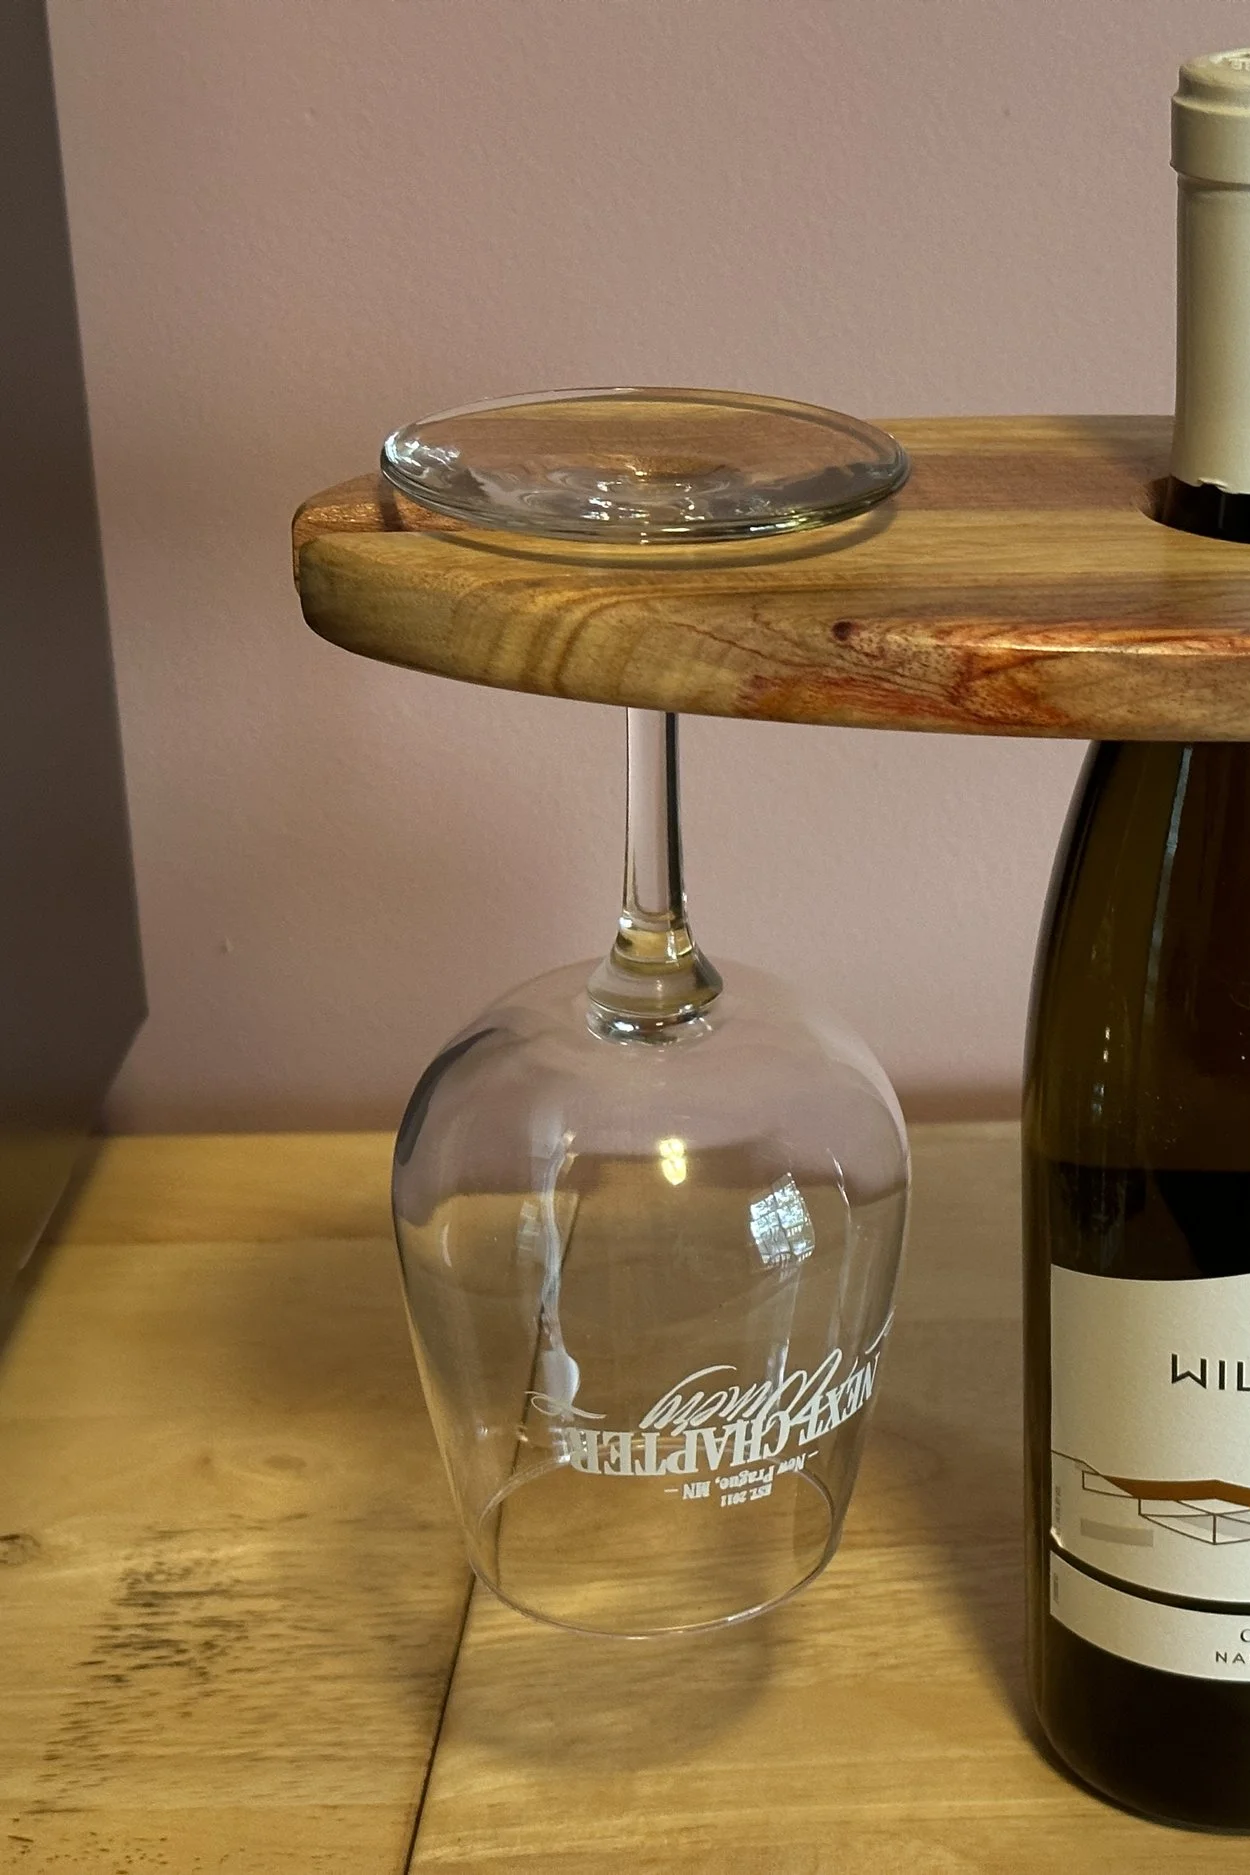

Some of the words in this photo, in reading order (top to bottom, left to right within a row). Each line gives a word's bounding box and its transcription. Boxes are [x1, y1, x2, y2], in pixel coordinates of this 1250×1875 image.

[638, 1347, 842, 1436] Winery
[798, 1351, 881, 1446] NEXT
[569, 1410, 793, 1476] CHAPTER
[714, 1464, 775, 1494] Prague,
[774, 1455, 806, 1476] New
[682, 1481, 711, 1501] MN
[719, 1491, 747, 1508] 2011
